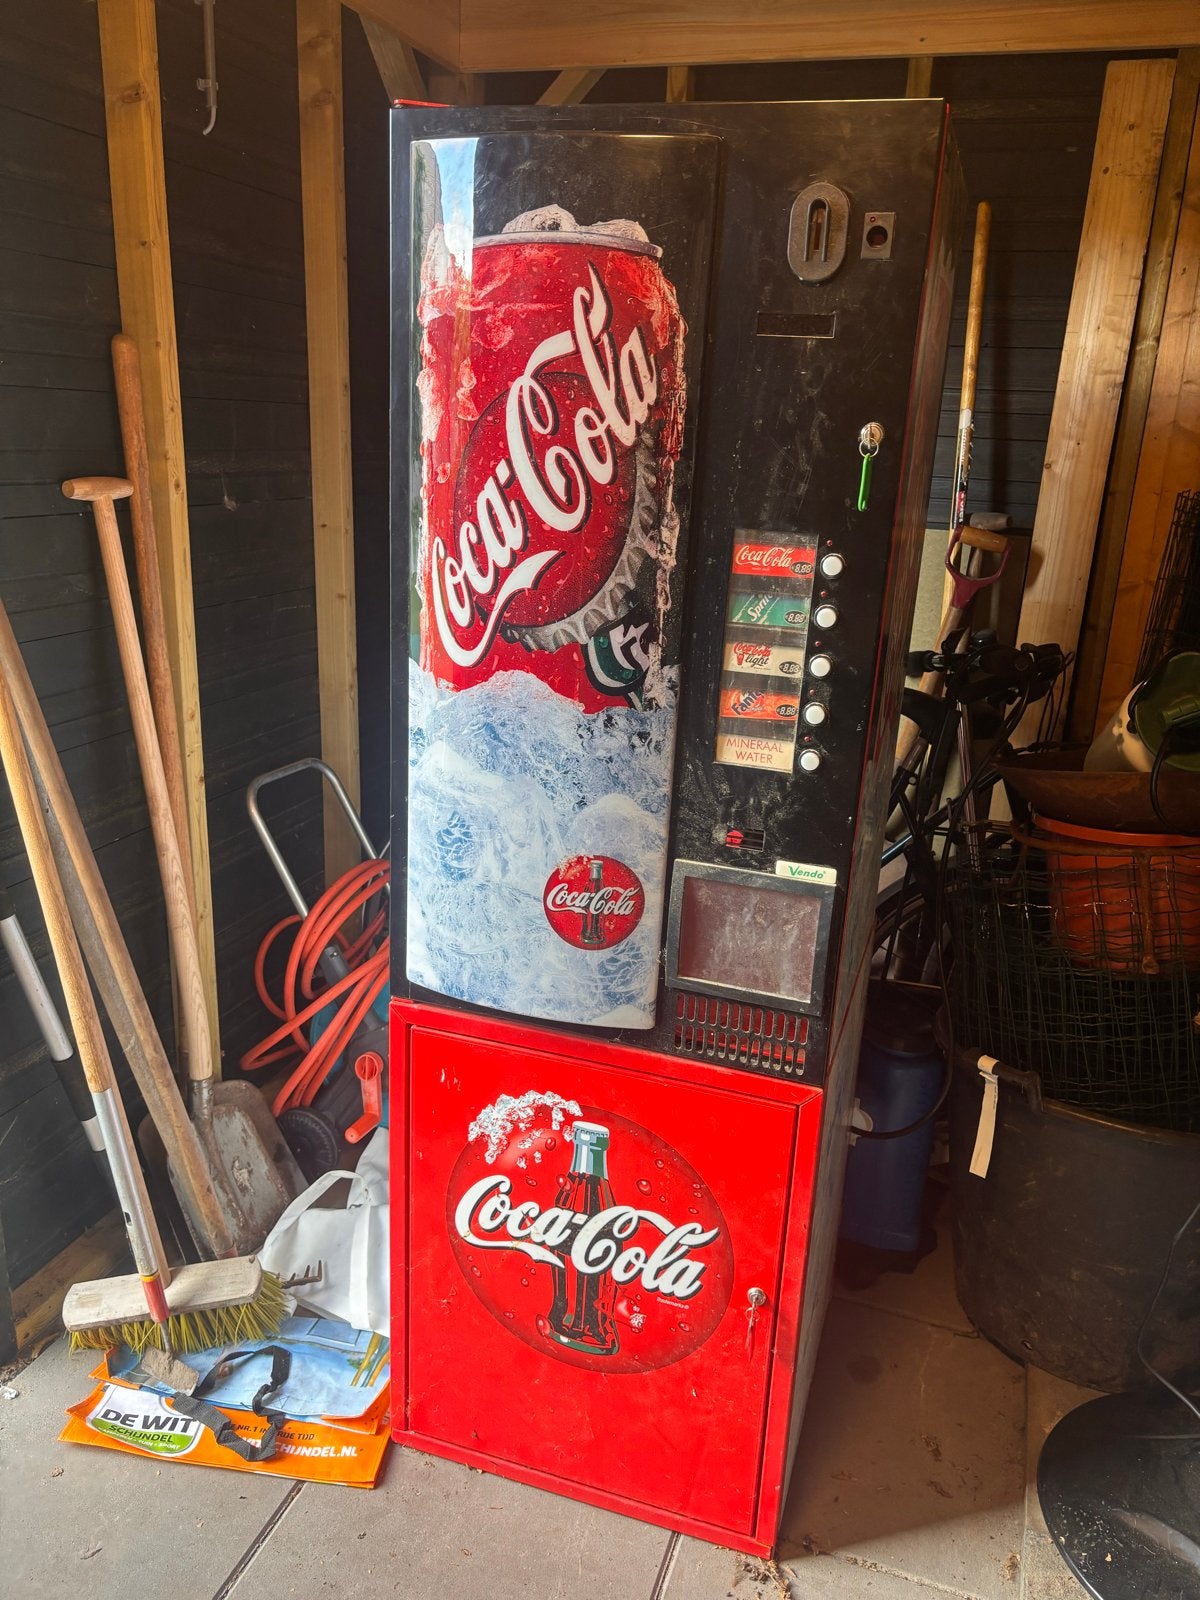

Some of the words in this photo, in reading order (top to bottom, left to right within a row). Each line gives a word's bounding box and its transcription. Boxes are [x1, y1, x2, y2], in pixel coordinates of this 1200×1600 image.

[431, 260, 658, 667] Coca-Cola
[735, 545, 795, 568] Coca-Cola
[726, 738, 784, 754] MINERAAL
[735, 750, 773, 764] WATER
[546, 882, 640, 916] Coca-Cola
[455, 1174, 719, 1298] Coca-Cola
[101, 1408, 139, 1428] DE
[141, 1415, 197, 1434] WIT
[108, 1424, 174, 1443] SCHIJNDEL
